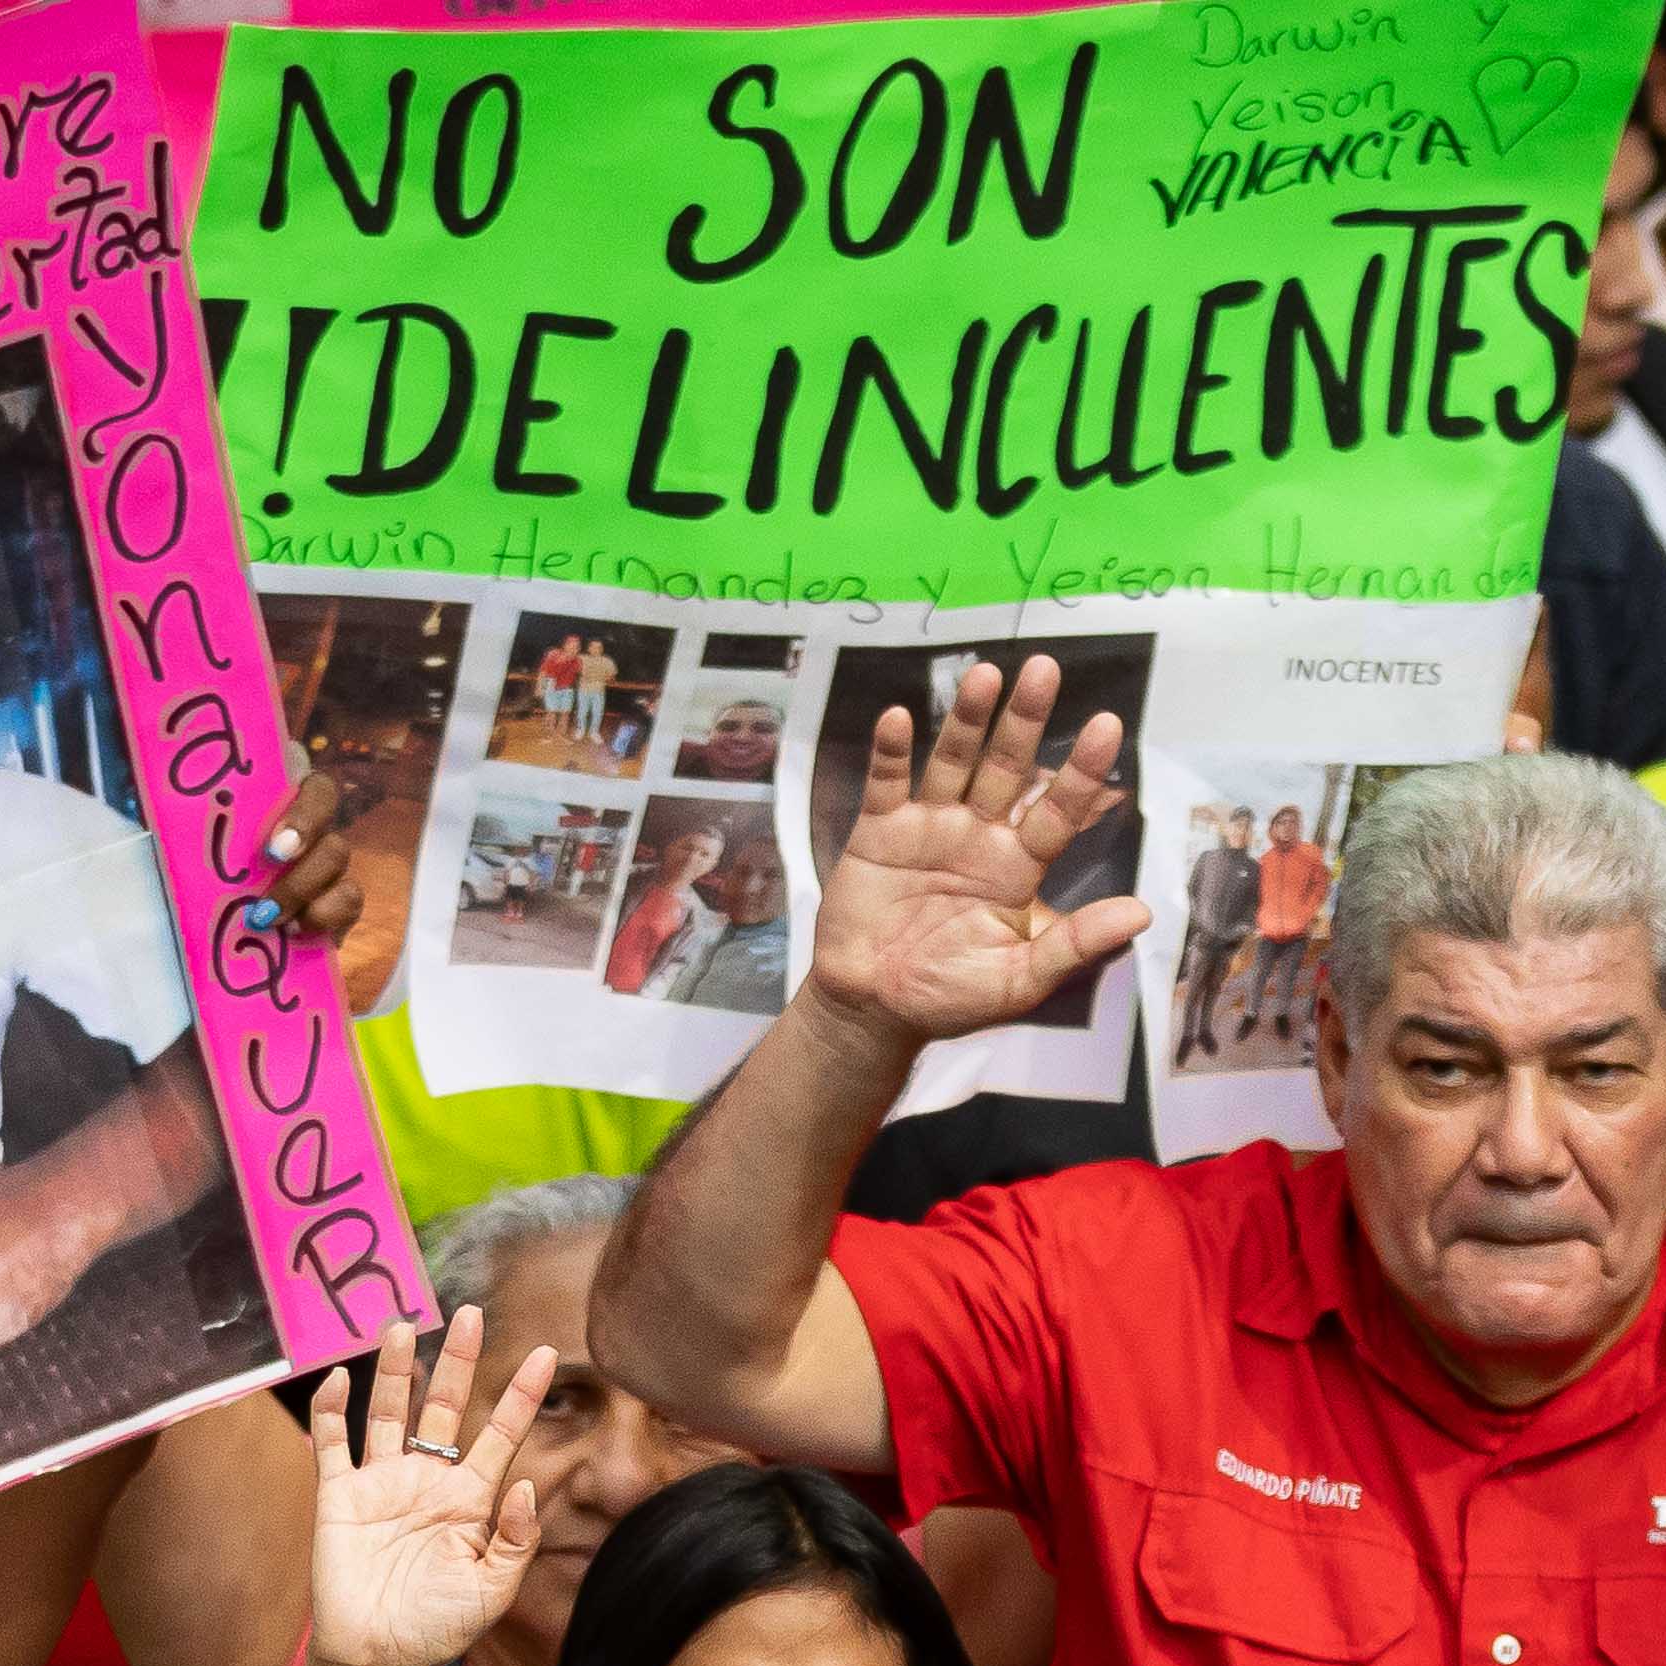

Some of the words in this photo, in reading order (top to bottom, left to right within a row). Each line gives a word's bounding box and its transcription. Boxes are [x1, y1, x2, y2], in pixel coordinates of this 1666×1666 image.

[1193, 4, 1406, 68] Darwin
[1193, 79, 1395, 166] Yeison
[259, 64, 523, 238] NO
[667, 42, 1101, 284] SON
[492, 517, 883, 624] Hernandez
[1284, 656, 1443, 686] INOCENTES
[1215, 1448, 1294, 1500] EDUARDO
[1295, 1474, 1363, 1510] PIÑATE
